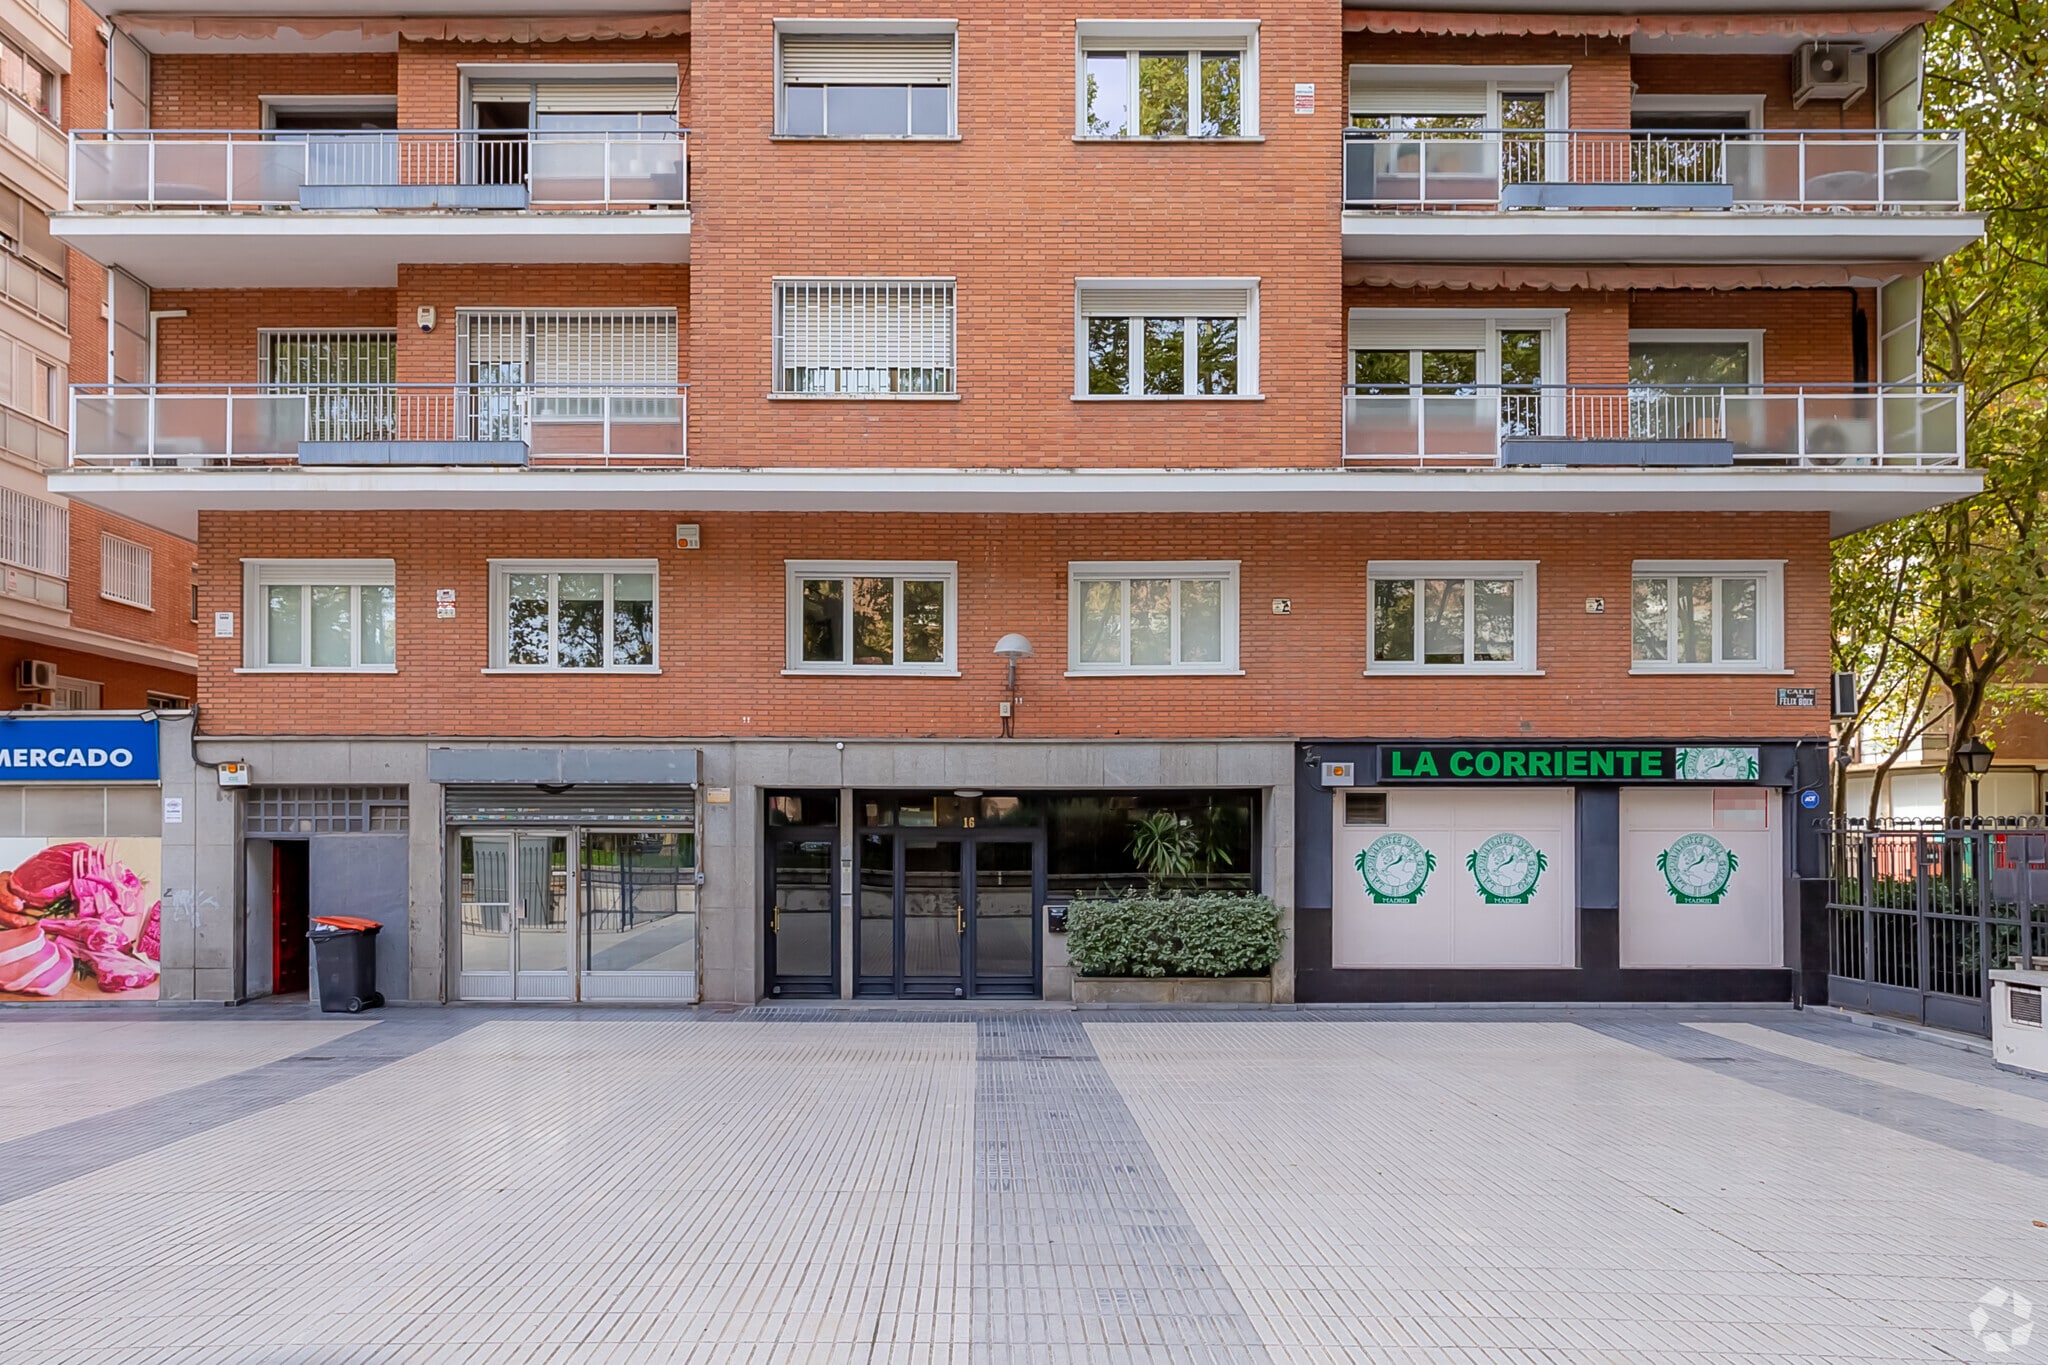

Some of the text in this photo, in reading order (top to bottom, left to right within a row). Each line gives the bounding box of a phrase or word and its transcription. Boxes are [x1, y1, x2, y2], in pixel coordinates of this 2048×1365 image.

[1798, 698, 1814, 706] BOIX
[1392, 751, 1439, 776] LA
[1450, 750, 1663, 777] CORRIENTE
[963, 816, 975, 828] 16
